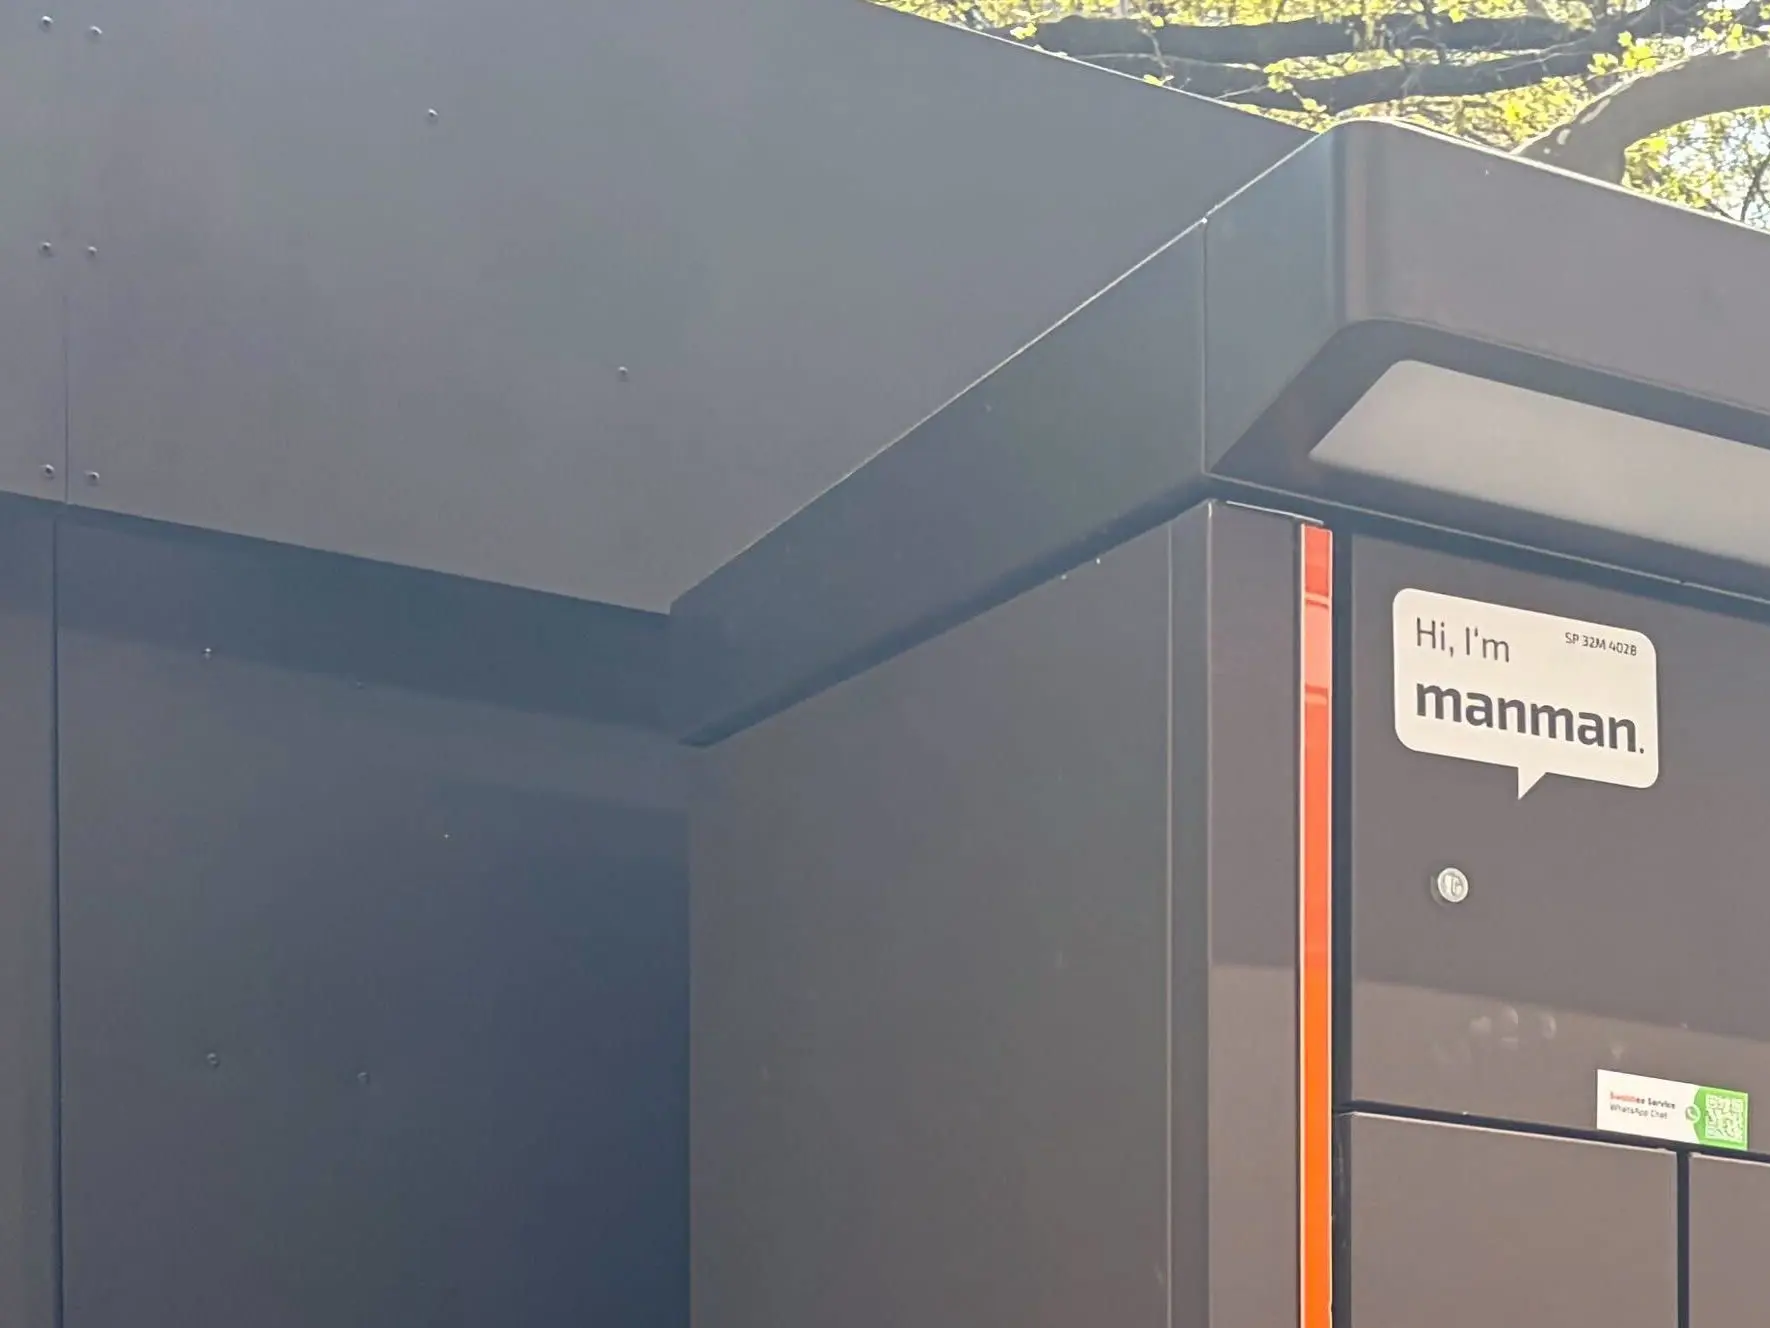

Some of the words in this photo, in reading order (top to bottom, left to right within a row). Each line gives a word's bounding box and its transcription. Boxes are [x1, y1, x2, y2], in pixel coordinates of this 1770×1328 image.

[1416, 616, 1454, 658] Hi,
[1465, 626, 1510, 663] I'm
[1565, 632, 1579, 645] SP
